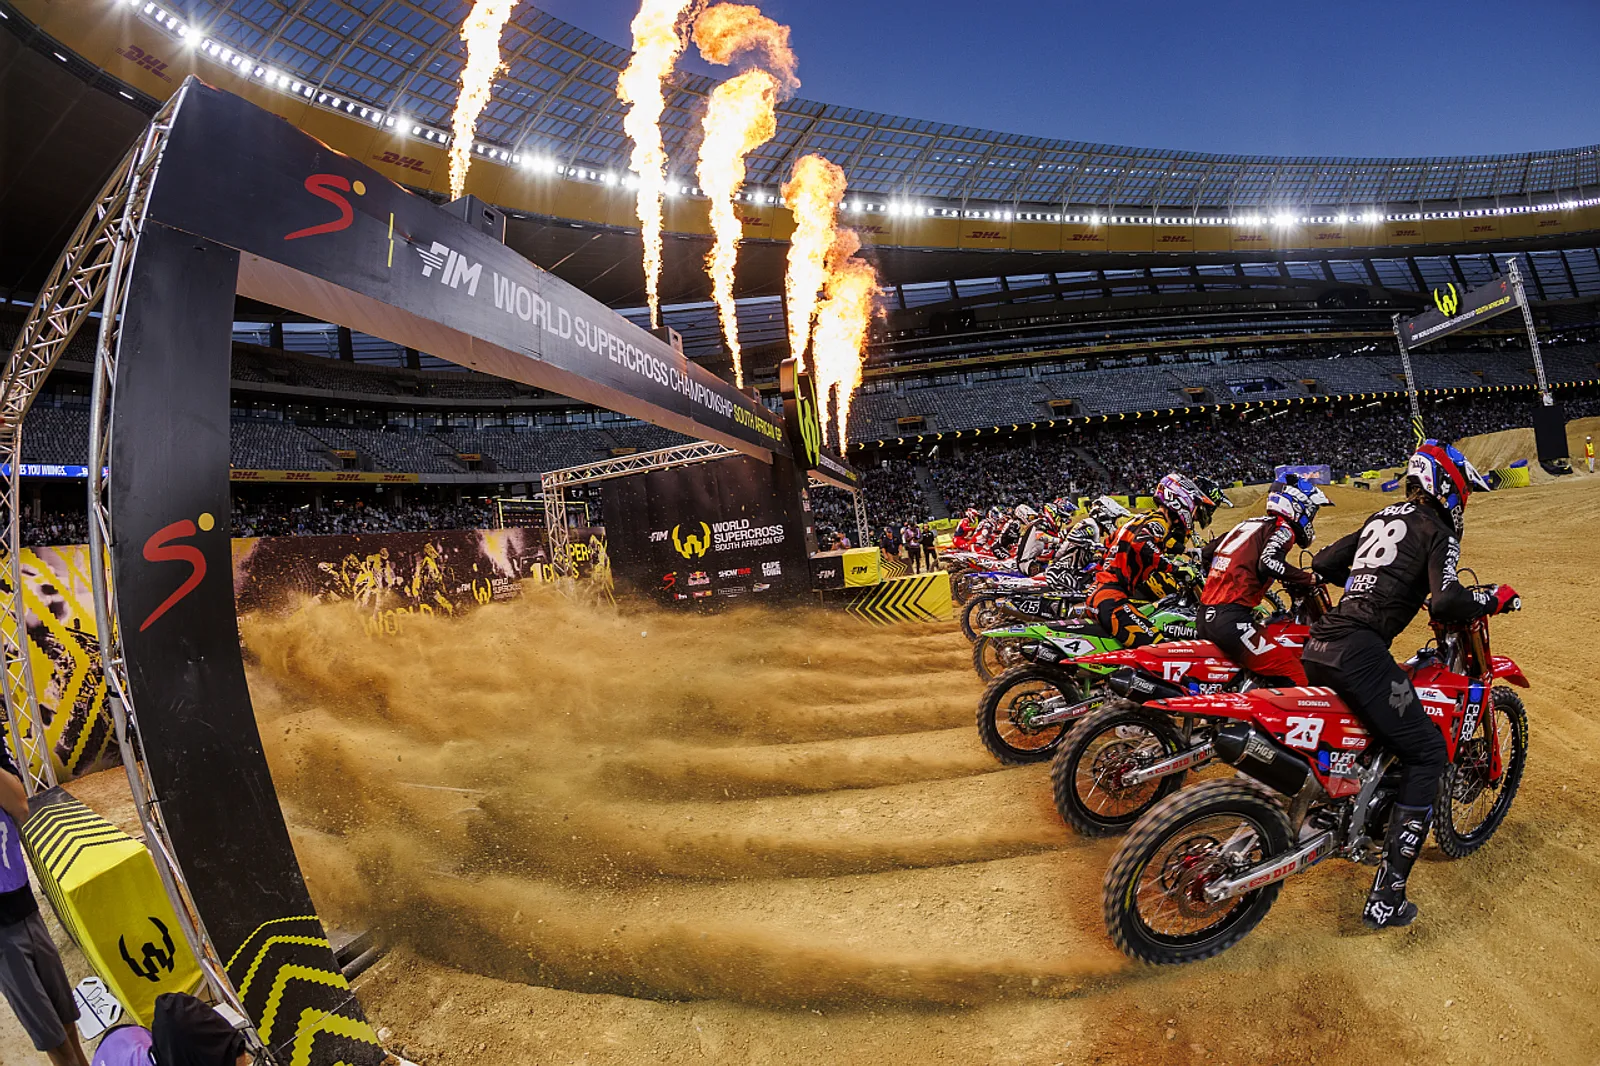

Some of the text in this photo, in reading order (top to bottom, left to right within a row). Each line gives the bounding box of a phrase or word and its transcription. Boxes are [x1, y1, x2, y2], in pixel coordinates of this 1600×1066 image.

[121, 44, 169, 80] DHL
[377, 151, 428, 173] DHL
[970, 231, 1003, 239] DHL
[416, 241, 482, 297] FIM
[493, 272, 572, 340] WORLD
[574, 316, 669, 387] SUPERCROSS
[669, 367, 733, 419] CHAMPIONSHIP
[733, 403, 754, 430] SOUTH
[754, 415, 775, 440] AFRICAN
[27, 464, 41, 476] YOU
[232, 471, 262, 480] DHL
[284, 472, 313, 480] DHL
[335, 473, 362, 481] DHL
[382, 474, 407, 482] DHL
[712, 518, 750, 534] WORLD
[713, 524, 784, 544] SUPERCROSS
[714, 541, 740, 552] SOUTH
[741, 537, 774, 549] AFRICAN
[1351, 518, 1408, 572] 28
[1019, 600, 1040, 614] 45
[1064, 640, 1081, 652] 4
[1162, 661, 1193, 682] 17
[1297, 700, 1331, 708] HONDA
[1284, 716, 1325, 750] 28
[1254, 742, 1277, 760] HGS
[1398, 831, 1421, 847] FOX
[1273, 861, 1297, 879] DID
[86, 986, 109, 1015] DIG
